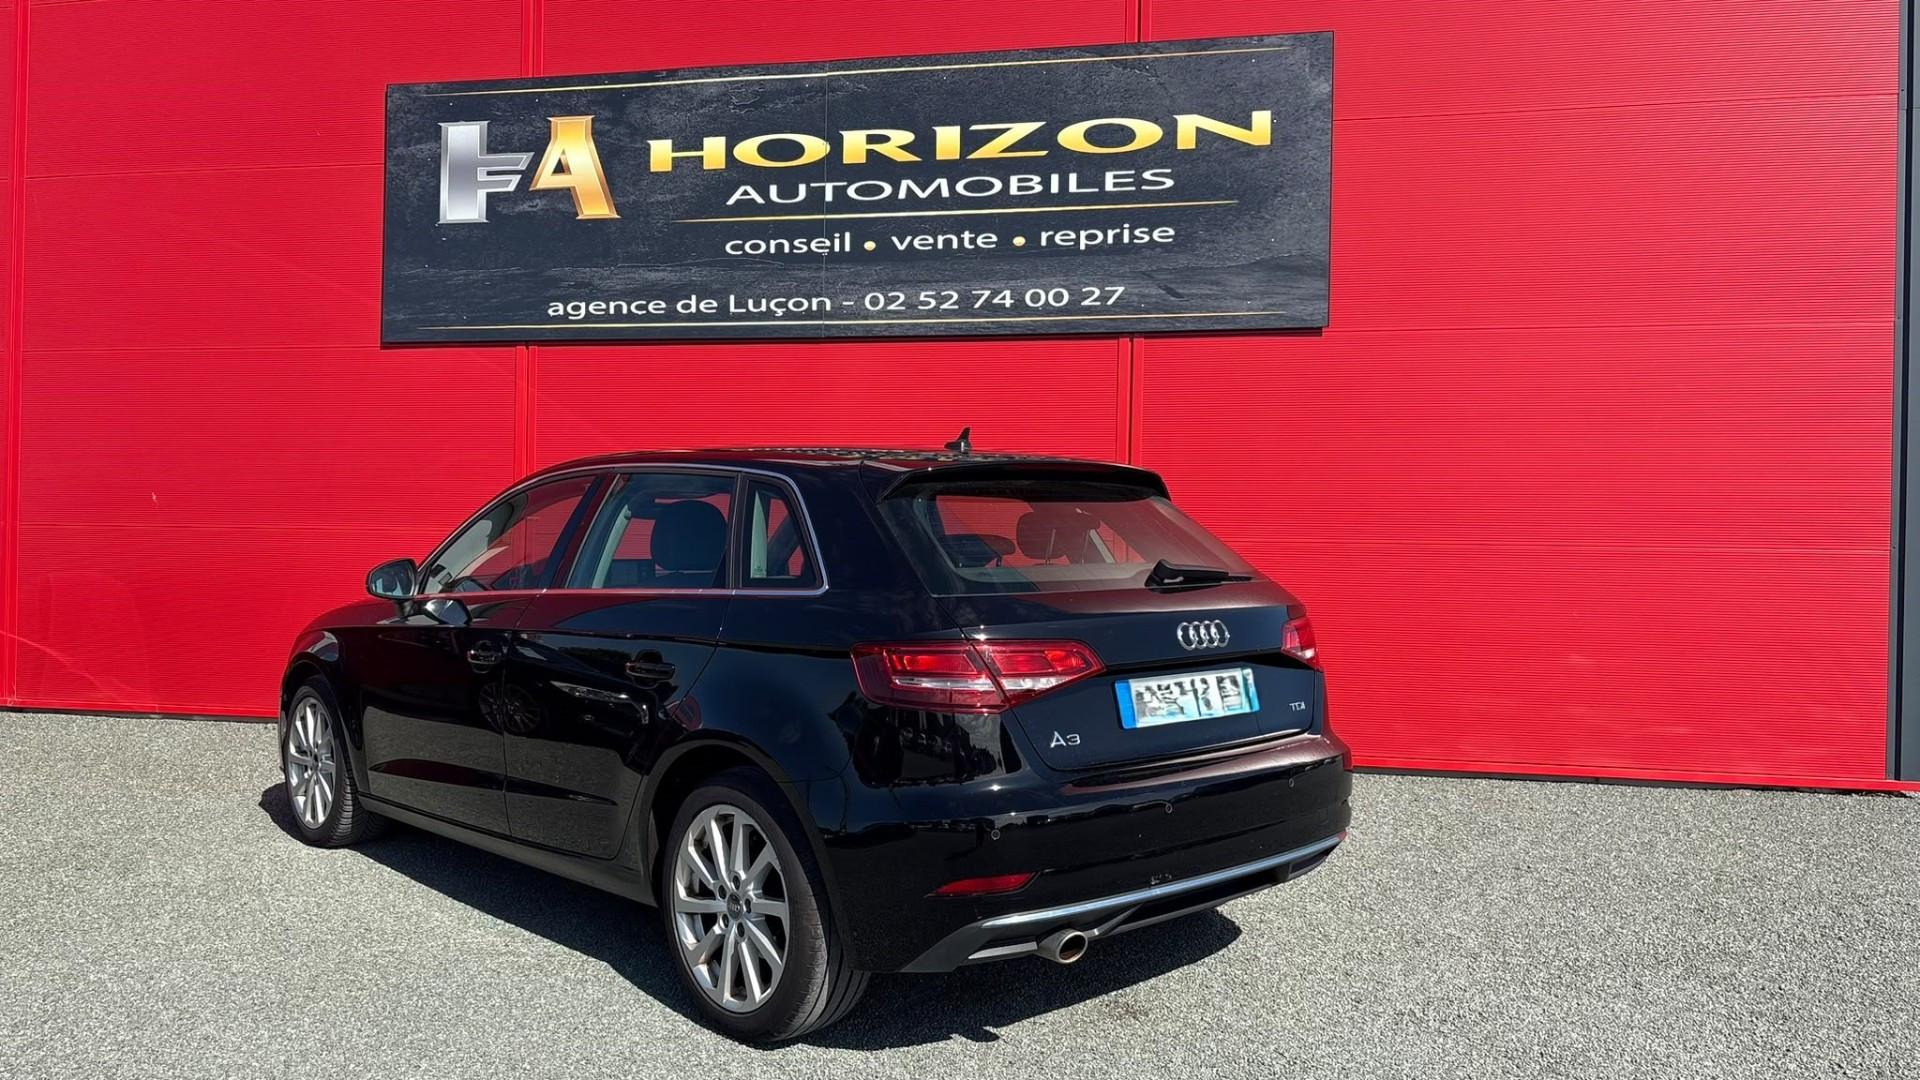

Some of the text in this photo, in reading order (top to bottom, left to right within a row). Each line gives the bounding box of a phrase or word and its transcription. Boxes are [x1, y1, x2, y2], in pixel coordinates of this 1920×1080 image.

[646, 109, 1272, 172] HORIZON
[726, 168, 1175, 206] AUTOMOBILES
[725, 222, 1175, 255] conseil vente reprise
[547, 300, 667, 320] agence
[676, 294, 719, 314] de
[729, 294, 832, 318] Luçon
[864, 291, 906, 311] 02
[917, 290, 959, 310] 52
[971, 289, 1015, 309] 74
[1024, 287, 1070, 308] 00
[1080, 286, 1126, 306] 27
[1049, 730, 1081, 749] A3
